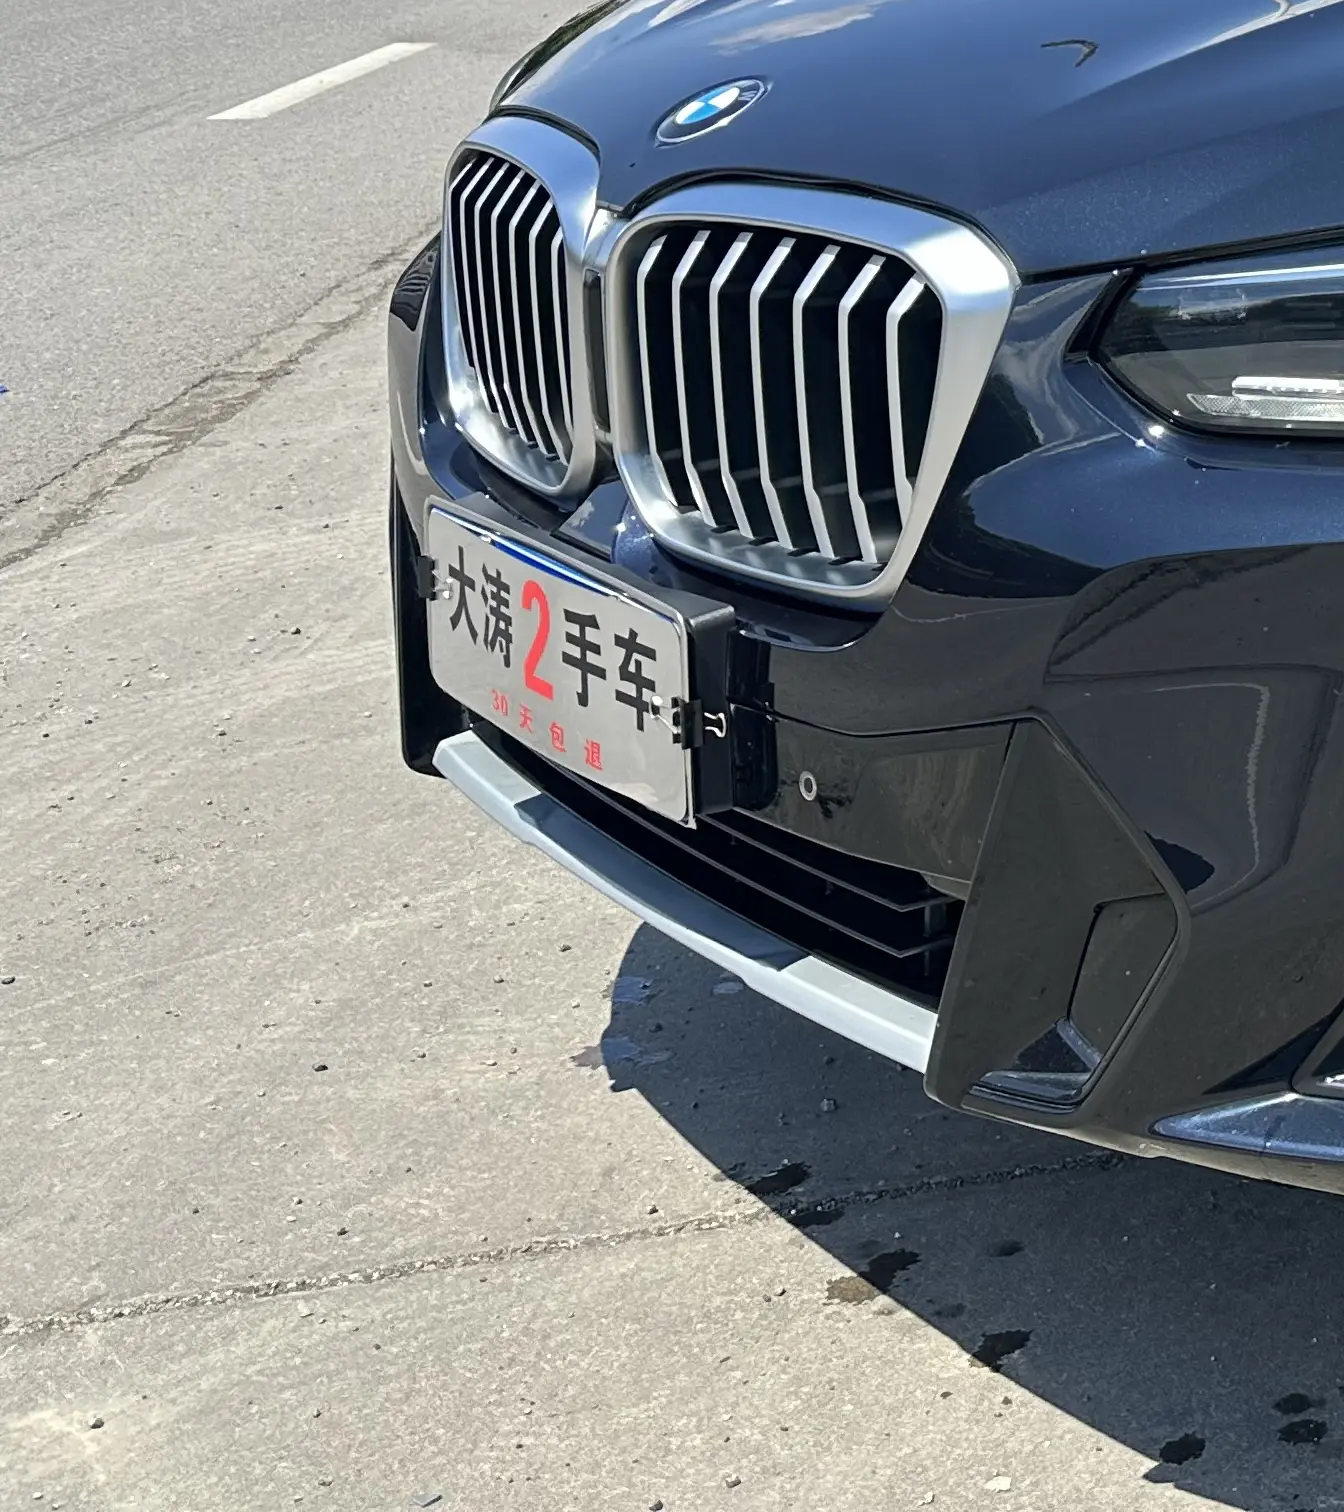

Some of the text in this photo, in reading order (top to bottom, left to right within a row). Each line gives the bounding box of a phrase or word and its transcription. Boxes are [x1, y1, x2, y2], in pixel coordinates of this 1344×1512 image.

[447, 544, 658, 732] 大涛2手车
[490, 688, 604, 771] 30天包退
